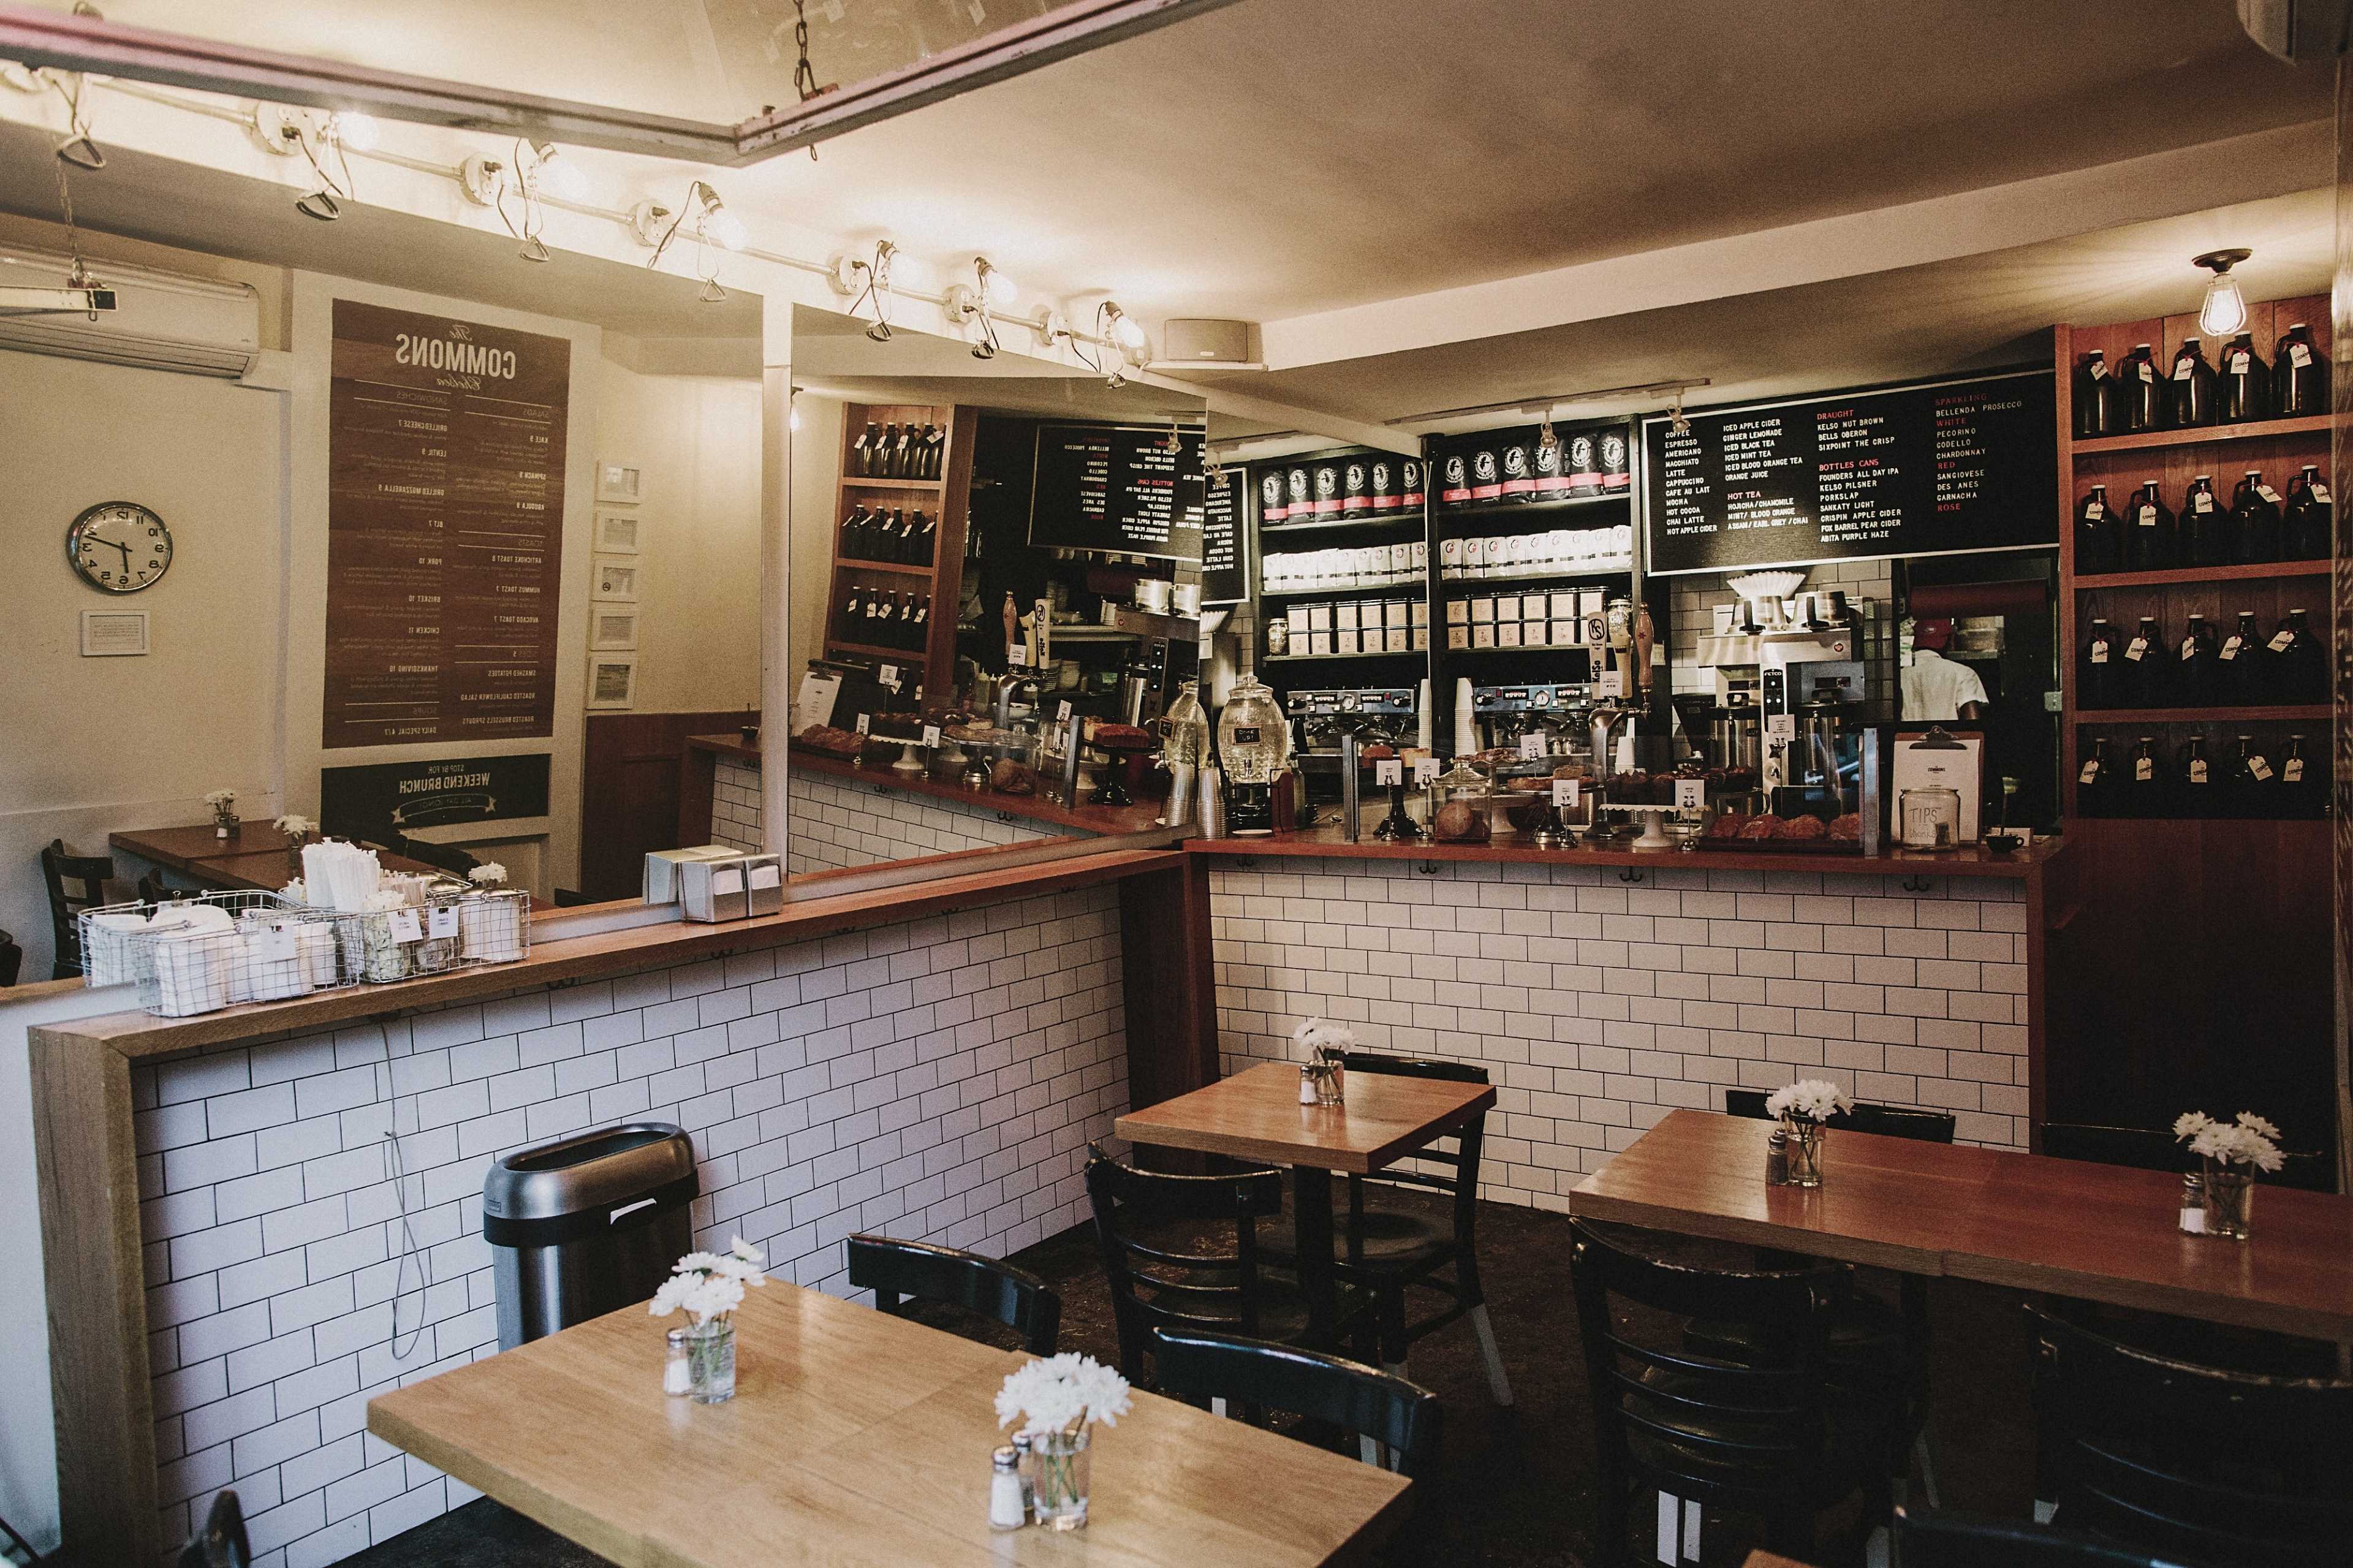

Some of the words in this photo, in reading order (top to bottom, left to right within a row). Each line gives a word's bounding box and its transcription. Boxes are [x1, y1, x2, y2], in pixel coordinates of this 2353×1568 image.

[1936, 407, 1976, 417] BELLENDA
[1983, 400, 2021, 412] PROSECCO
[1817, 409, 1854, 420] DRAUGHT
[1761, 419, 1781, 427] CIDER
[1817, 422, 1838, 431] KELSO
[1843, 420, 1857, 428] NUT
[1859, 417, 1884, 426] BROWN
[1936, 417, 1966, 426] WHITE
[1665, 430, 1690, 439] COFFEE
[1723, 433, 1747, 442] GINGER
[1749, 428, 1783, 439] LEMONADE
[1818, 433, 1838, 441] BELLS
[1841, 429, 1868, 439] OBERON
[1937, 428, 1976, 438] PECORINO
[1665, 439, 1697, 449] ESPRESSO
[1741, 441, 1760, 450] BLACK
[1819, 441, 1851, 452] SIXPOINT
[1855, 439, 1869, 448] THE
[1873, 436, 1895, 445] CRISP
[1665, 448, 1702, 458] AMERICANO
[1936, 448, 1986, 460] CHARDONNAY
[1665, 458, 1699, 468] MACCHIATO
[1741, 461, 1760, 470] BLOOD
[1763, 458, 1788, 468] ORANGE
[1819, 461, 1854, 471] BOTTLES
[1665, 469, 1686, 477] LATTE
[1725, 472, 1749, 481] ORANGE
[1819, 472, 1853, 482] FOUNDERS
[1857, 470, 1870, 479] ALL
[1937, 469, 1985, 480] SANGIOVESE
[1665, 477, 1704, 487] CAPPUCCINO
[1820, 483, 1842, 492] KELSO
[1845, 480, 1877, 490] PILSNER
[1957, 480, 1979, 490] ANES
[1727, 492, 1743, 501] HOT
[1820, 492, 1859, 502] PORKSLAP
[1820, 503, 1851, 512] SANKATY
[1854, 501, 1874, 509] LIGHT
[1938, 503, 1961, 512] ROSE
[1751, 510, 1771, 518] BLOOD
[1772, 507, 1795, 516] ORANGE
[1821, 513, 1847, 523] CRISPIN
[1852, 510, 1876, 520] APPLE
[1879, 509, 1901, 517] CIDER
[1684, 515, 1705, 525] LATTE
[1835, 522, 1859, 531] BARREL
[1881, 519, 1901, 528] CIDER
[1821, 534, 1840, 543] ABITA
[1842, 532, 1868, 541] PURPLE
[1871, 530, 1889, 539] HAZE
[1908, 808, 1939, 823] TIPS
